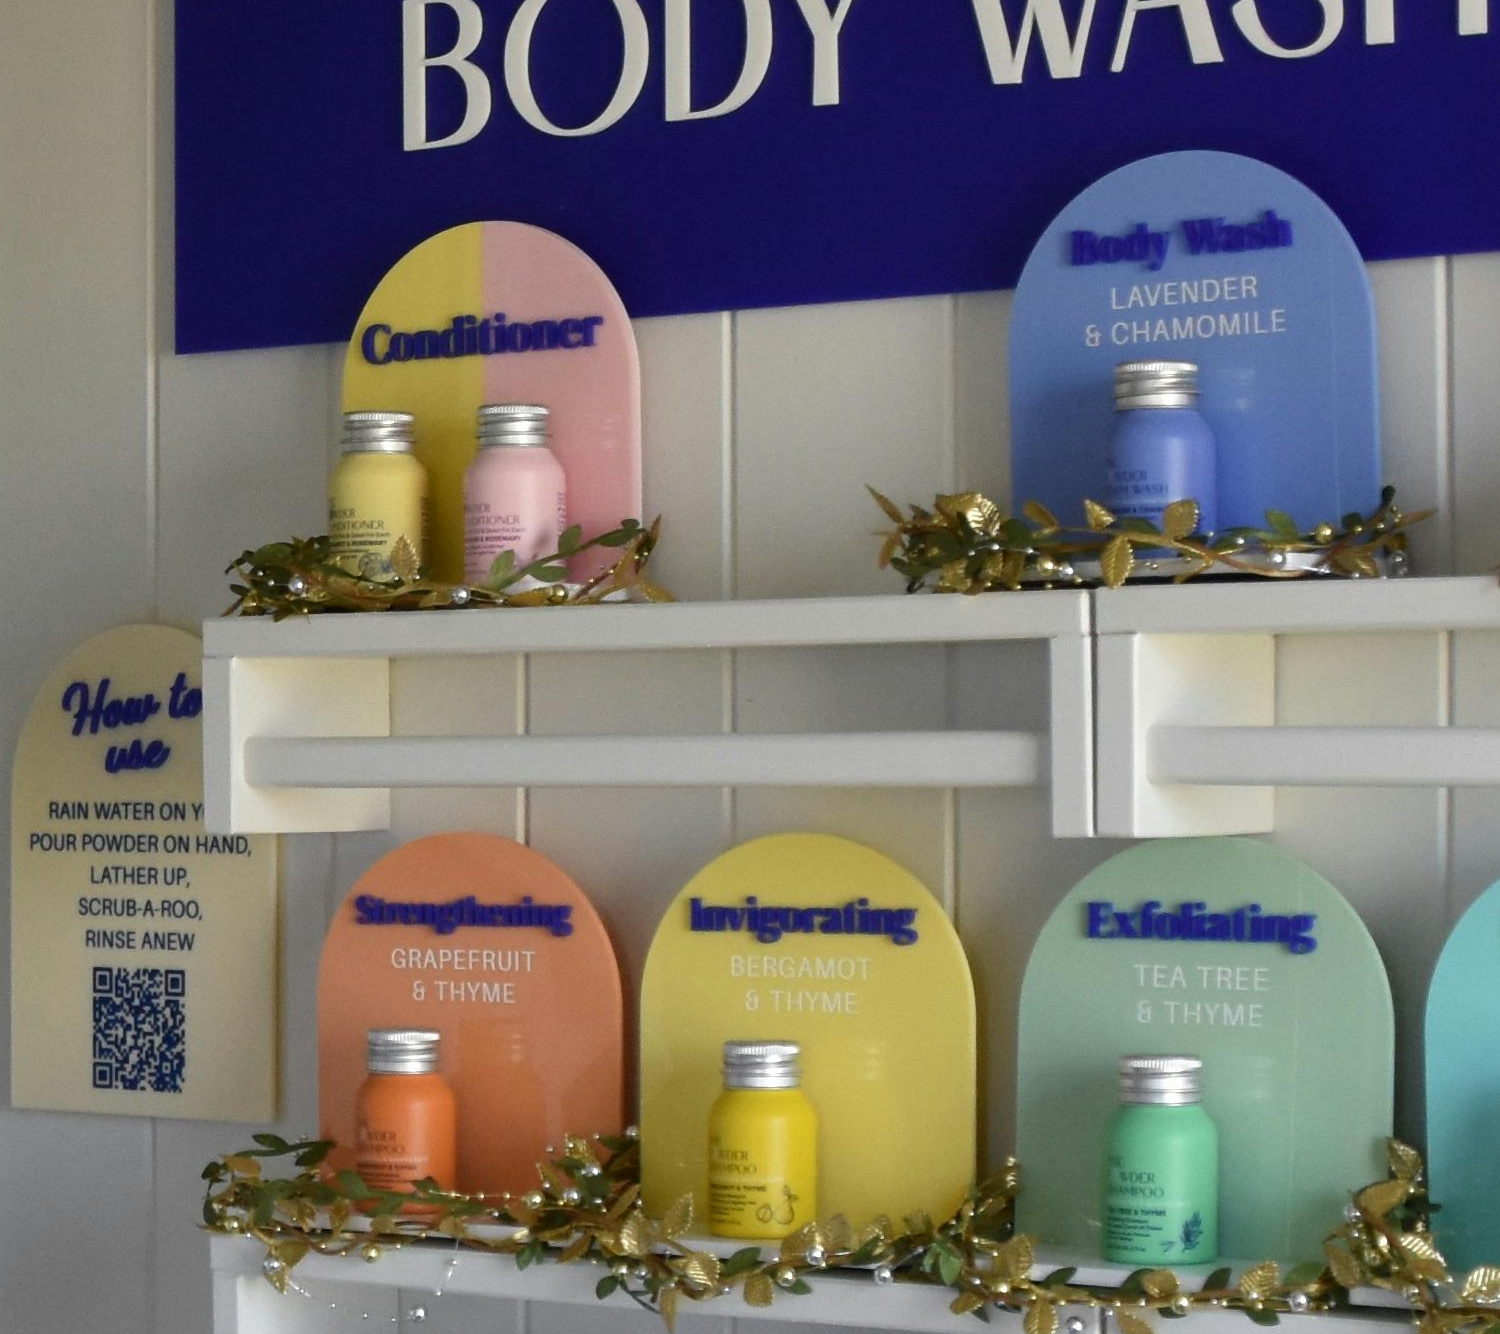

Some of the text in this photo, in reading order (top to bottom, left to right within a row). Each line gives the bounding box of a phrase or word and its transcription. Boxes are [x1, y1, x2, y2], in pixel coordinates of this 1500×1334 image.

[1069, 210, 1294, 270] Body Wash
[1112, 275, 1258, 310] LAVENDER
[361, 313, 603, 365] Conditioner
[1085, 309, 1287, 347] & CHAMOMILE
[62, 673, 203, 737] How to
[105, 738, 170, 775] use
[49, 802, 89, 821] RAIN
[94, 803, 154, 821] WATER
[158, 803, 186, 821] ON
[29, 833, 252, 857] POUR POWDER ON HAND,
[90, 867, 191, 889] LATHER UP,
[78, 897, 204, 921] SCRUB-A-ROO,
[354, 894, 573, 937] Strengthening
[688, 896, 919, 946] Invigorating
[1086, 900, 1319, 954] Exfoliating
[85, 930, 196, 952] RINSE ANEW
[391, 948, 535, 972] GRAPEFRUIT
[731, 955, 872, 981] BERGAMOT
[1134, 965, 1269, 991] TEA TREE
[413, 981, 516, 1004] & THYME
[745, 990, 859, 1014] & THYME
[1137, 1001, 1265, 1028] & THYME
